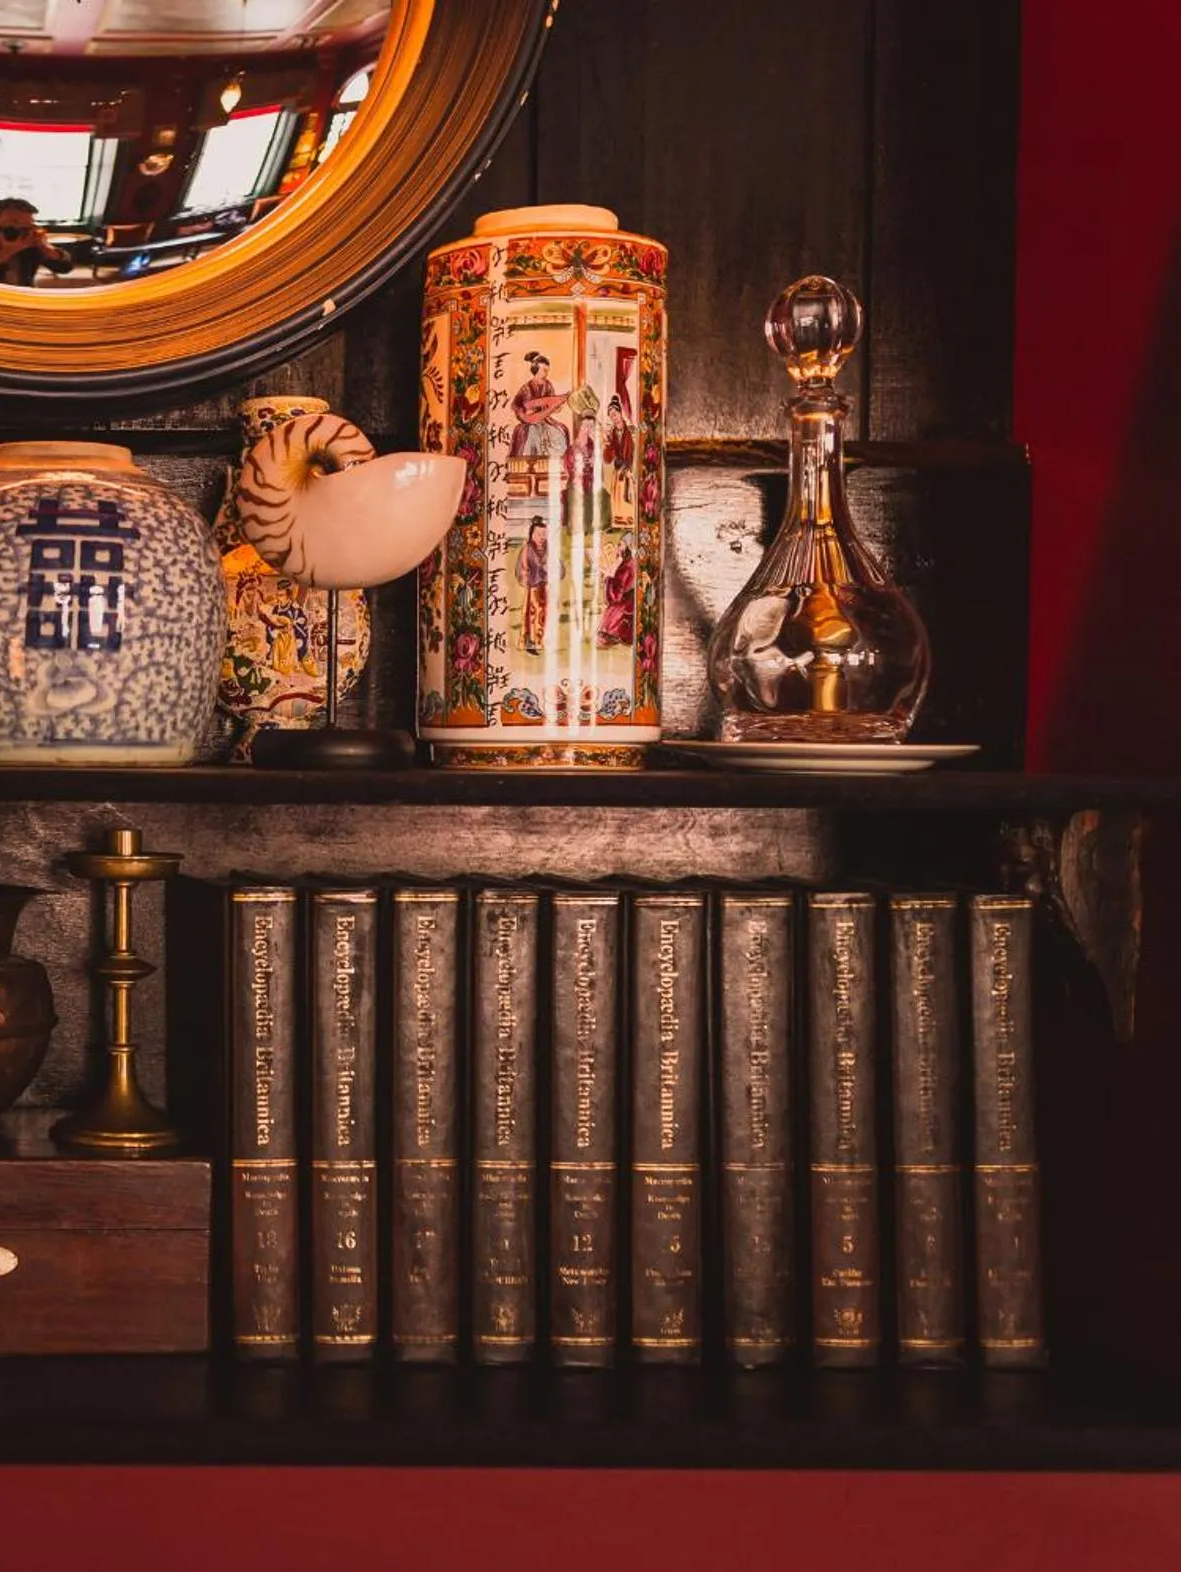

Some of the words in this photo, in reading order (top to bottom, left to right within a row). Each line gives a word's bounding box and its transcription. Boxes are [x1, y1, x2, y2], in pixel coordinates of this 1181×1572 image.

[252, 915, 274, 1037] Encyclopædia
[658, 920, 680, 1042] Encyclopædia
[255, 1047, 274, 1145] Britannica
[336, 1047, 356, 1146] Britannica
[417, 1046, 436, 1146] Britannica
[497, 1048, 517, 1145] Britannica
[577, 1050, 596, 1147] Britannica
[661, 1051, 680, 1150] Britannica
[337, 1231, 357, 1249] 16
[573, 1233, 594, 1252] 12
[842, 1235, 855, 1254] 5
